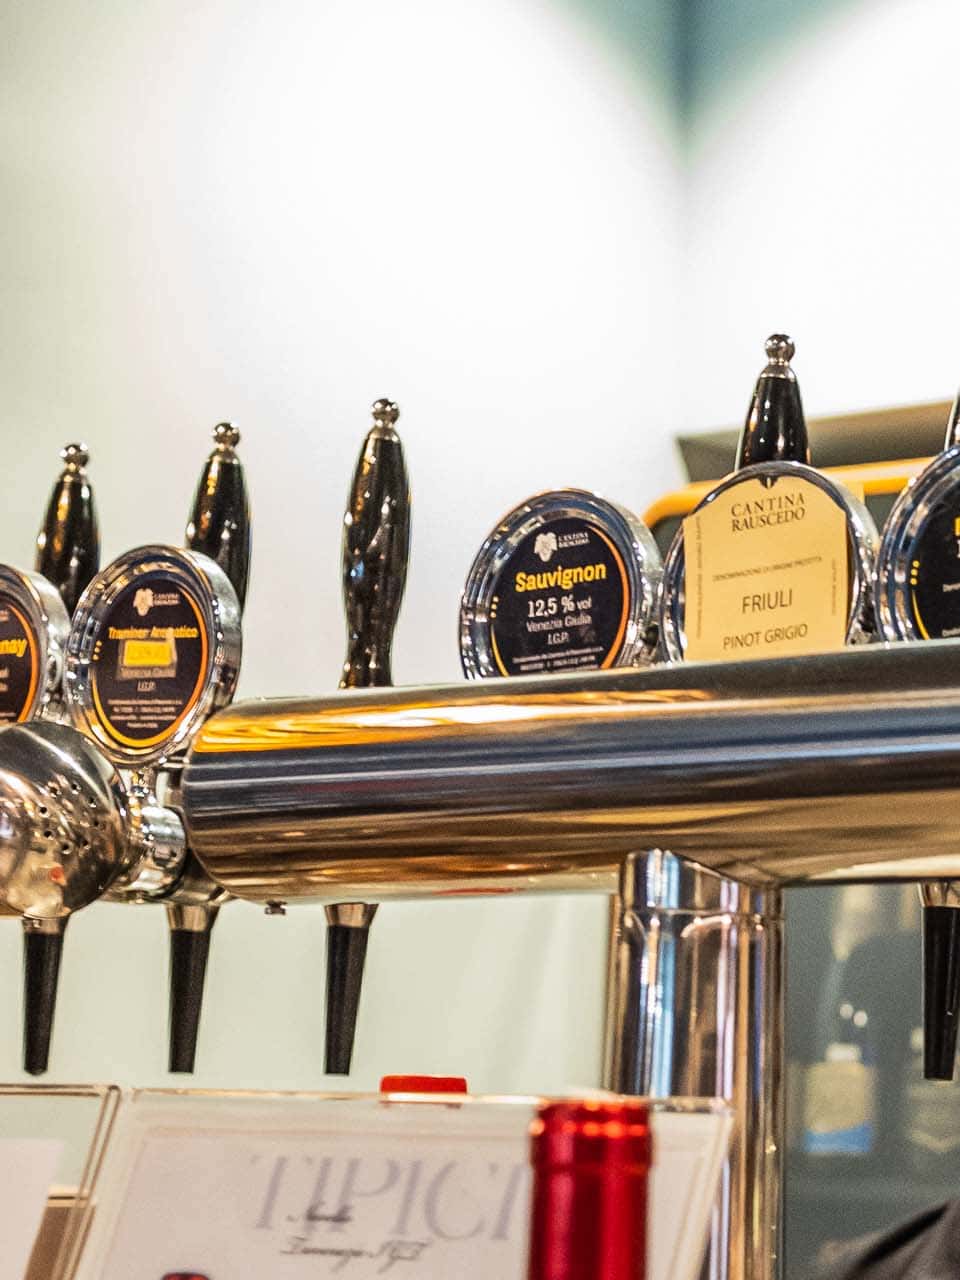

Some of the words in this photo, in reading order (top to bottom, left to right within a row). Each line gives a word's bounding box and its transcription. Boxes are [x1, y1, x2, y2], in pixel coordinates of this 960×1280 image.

[731, 493, 805, 518] CANTINA
[732, 507, 806, 532] RAUSCEDO
[515, 563, 607, 593] Sauvignon
[561, 594, 575, 613] %
[577, 596, 593, 611] vol
[742, 588, 793, 614] FRIULI
[723, 631, 762, 650] PINOT
[764, 623, 808, 644] GRIGIO
